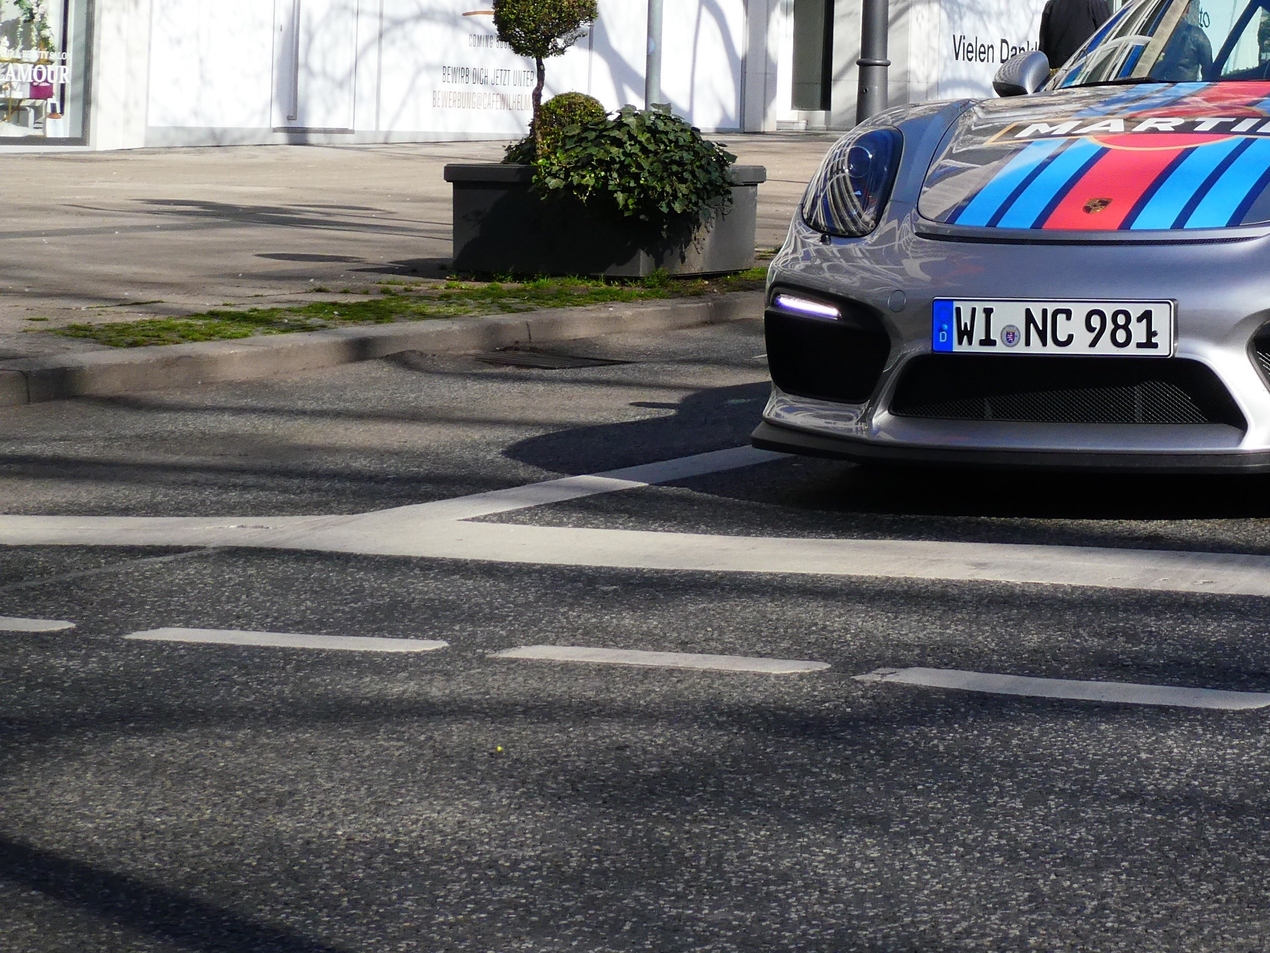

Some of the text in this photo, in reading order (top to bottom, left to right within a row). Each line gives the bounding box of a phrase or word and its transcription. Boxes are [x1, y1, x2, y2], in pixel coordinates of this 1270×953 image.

[469, 33, 493, 48] COMING
[953, 34, 995, 63] Vielen
[442, 65, 535, 87] BEWIRB DICH JETZT UNTER
[939, 331, 947, 342] D
[955, 306, 1158, 349] WI NC 981
